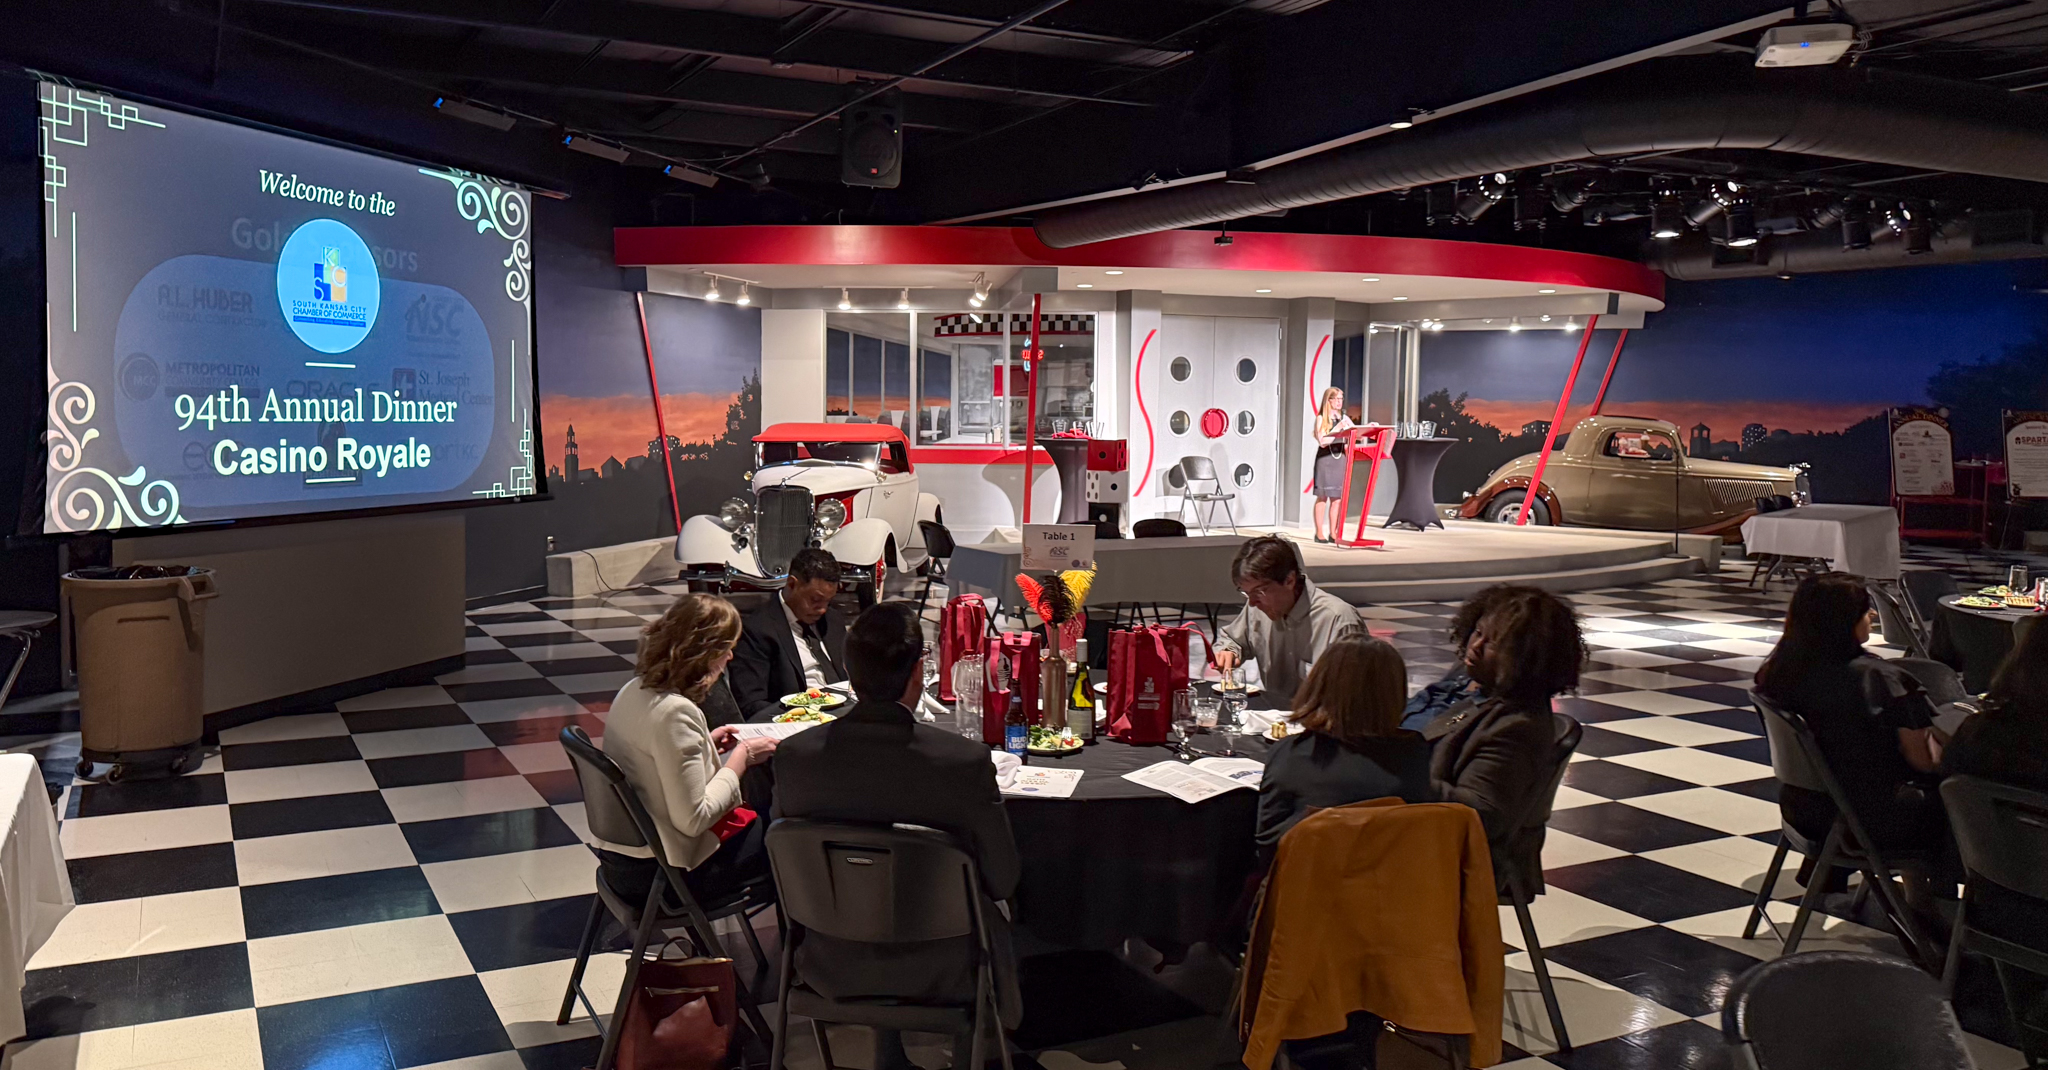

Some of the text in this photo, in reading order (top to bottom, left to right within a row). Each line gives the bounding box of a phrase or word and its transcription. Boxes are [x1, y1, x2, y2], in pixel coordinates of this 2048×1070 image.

[260, 169, 396, 217] Welcome to the
[193, 286, 253, 313] HUBER
[292, 300, 367, 313] SOUTH KANSAS CITY
[292, 307, 367, 321] CHAMBER OF COMMERCE
[165, 362, 260, 377] METROPOLITAN
[133, 375, 156, 386] MCC
[166, 375, 222, 387] COMMUNITY
[419, 369, 470, 389] St. Joseph
[462, 390, 493, 405] Center
[174, 384, 458, 431] 94th Annual Dinner
[213, 438, 328, 476] Casino
[337, 436, 431, 478] Royale
[1042, 532, 1075, 541] Table 1
